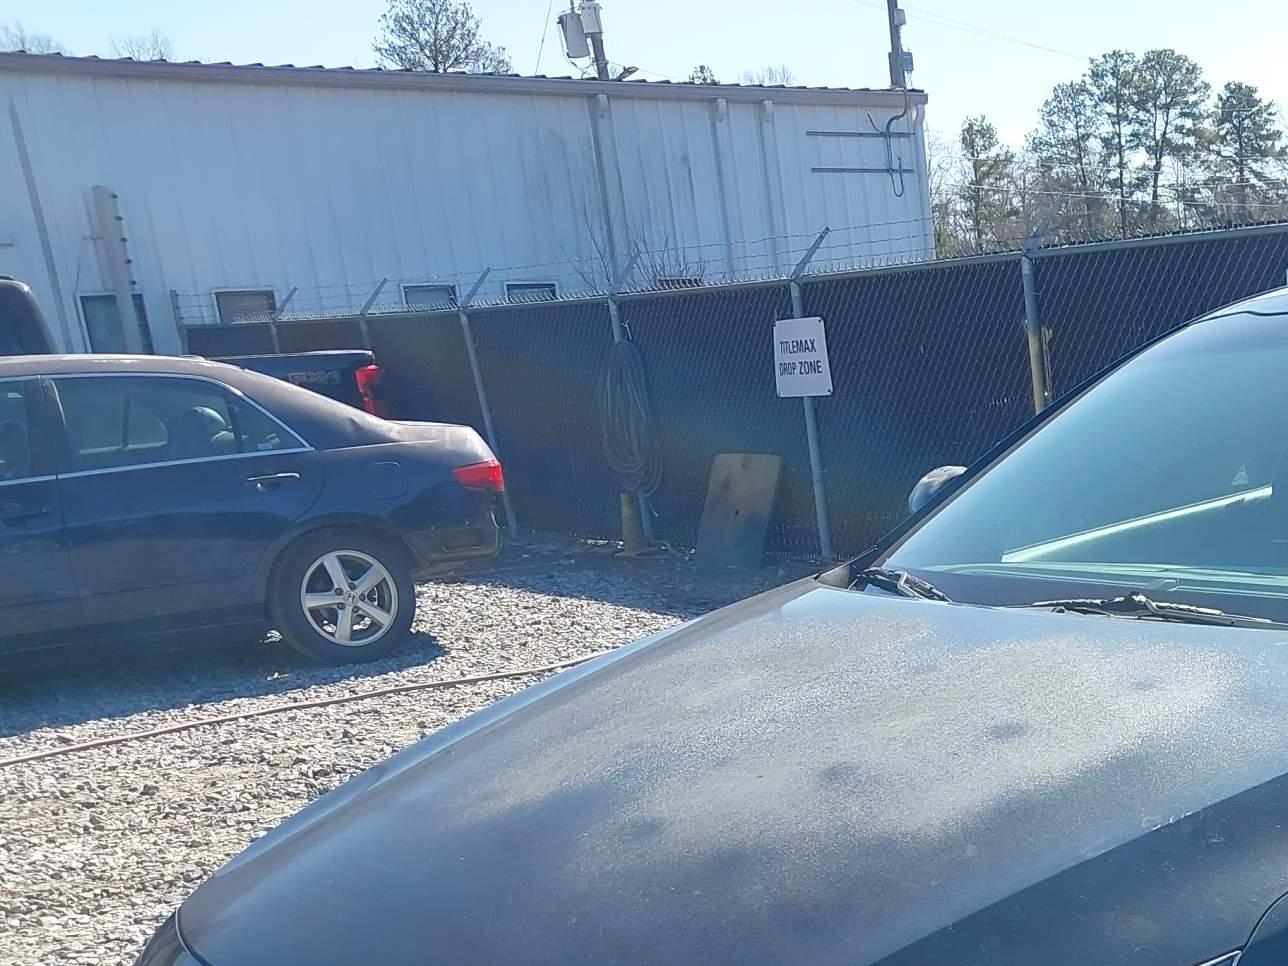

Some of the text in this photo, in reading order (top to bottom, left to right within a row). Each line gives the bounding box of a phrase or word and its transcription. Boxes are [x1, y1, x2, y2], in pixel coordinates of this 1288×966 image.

[779, 339, 817, 355] TITLEMAX
[779, 360, 823, 376] DROP ZONE
